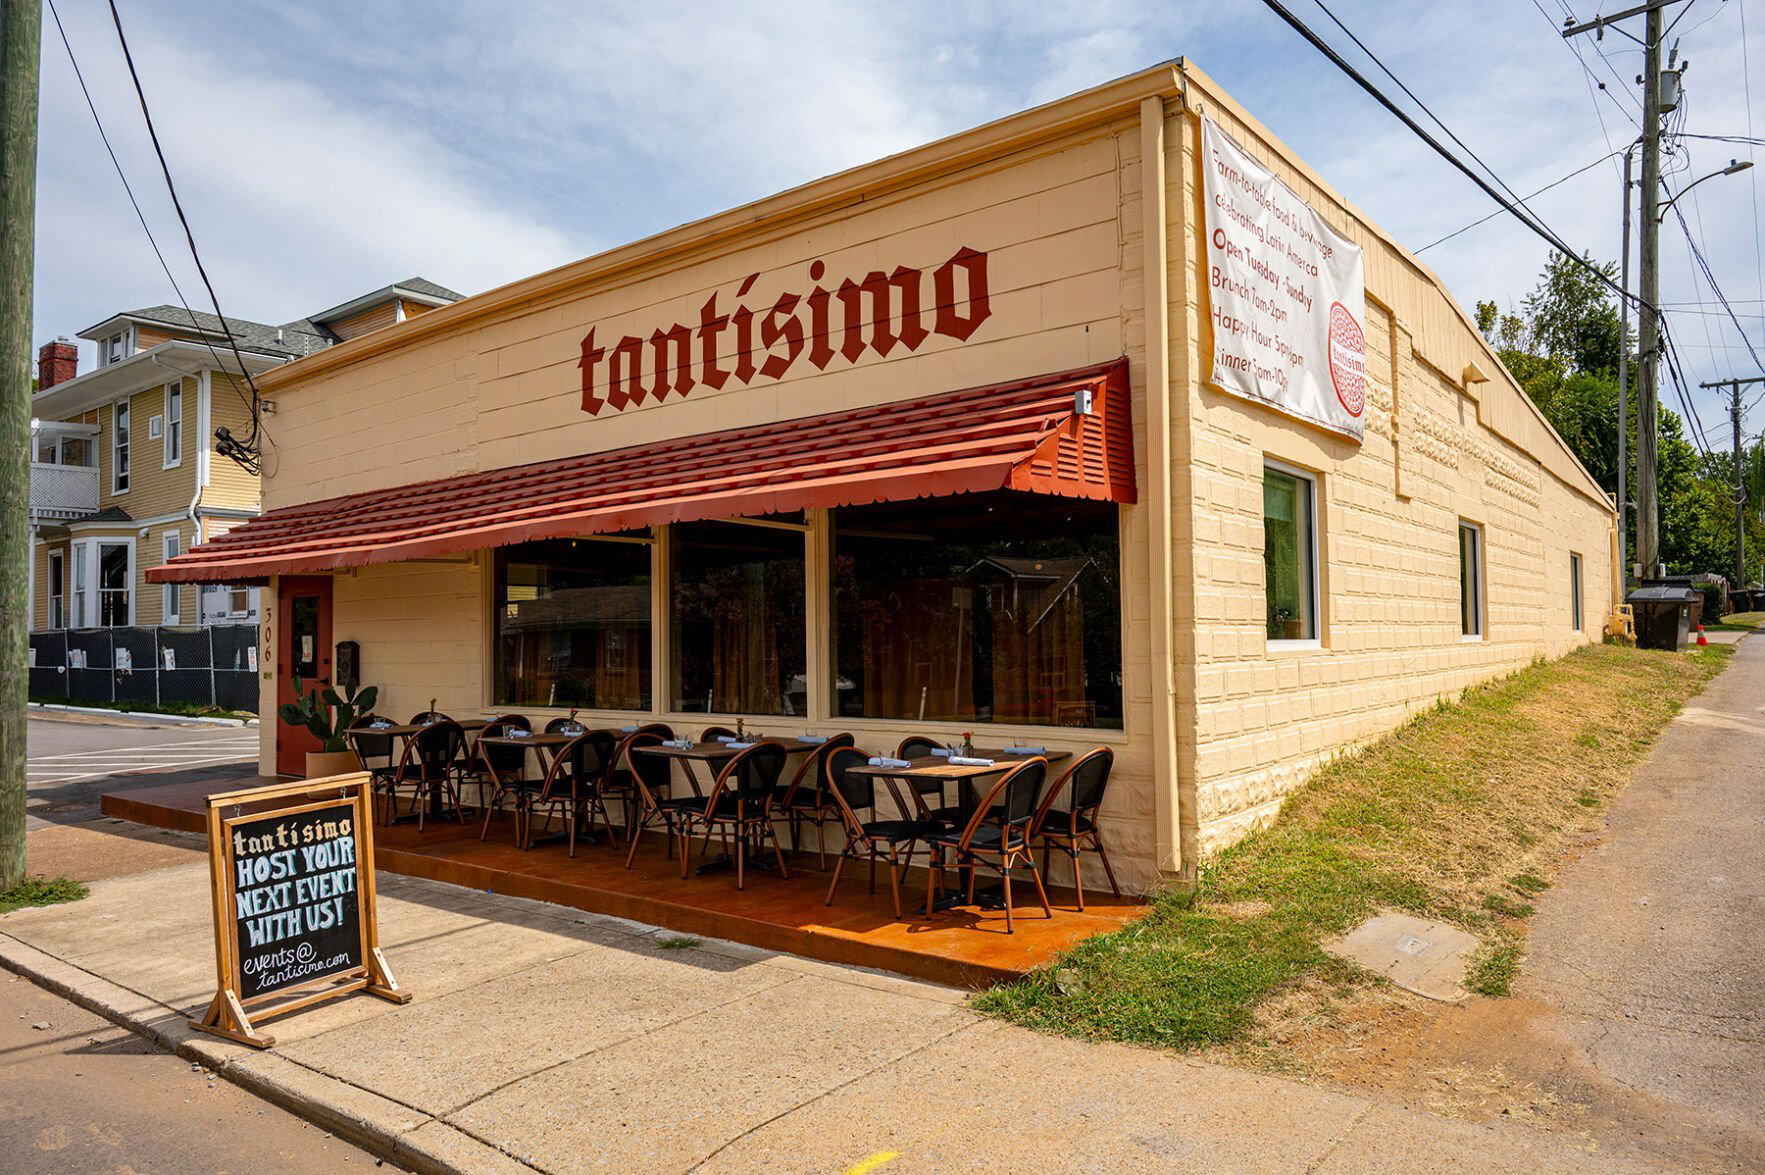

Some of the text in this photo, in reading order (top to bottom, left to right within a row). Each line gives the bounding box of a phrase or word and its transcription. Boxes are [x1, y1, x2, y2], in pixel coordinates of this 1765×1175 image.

[1213, 149, 1333, 259] Farm-to-table food & bvage
[1213, 228, 1312, 313] Open Tuesday -Sundy
[1266, 224, 1284, 252] Latin
[1287, 243, 1318, 277] Amerca
[1212, 266, 1249, 302] Brunch
[578, 246, 992, 416] tantísimo
[1251, 320, 1272, 349] Hour
[1275, 335, 1304, 369] 5pm6pm
[1217, 346, 1251, 372] inner
[264, 608, 272, 661] 306
[236, 836, 355, 887] HOST YOUR
[235, 867, 356, 919] NEXT EVENT
[245, 897, 343, 947] WITH US!
[243, 942, 317, 974] events@
